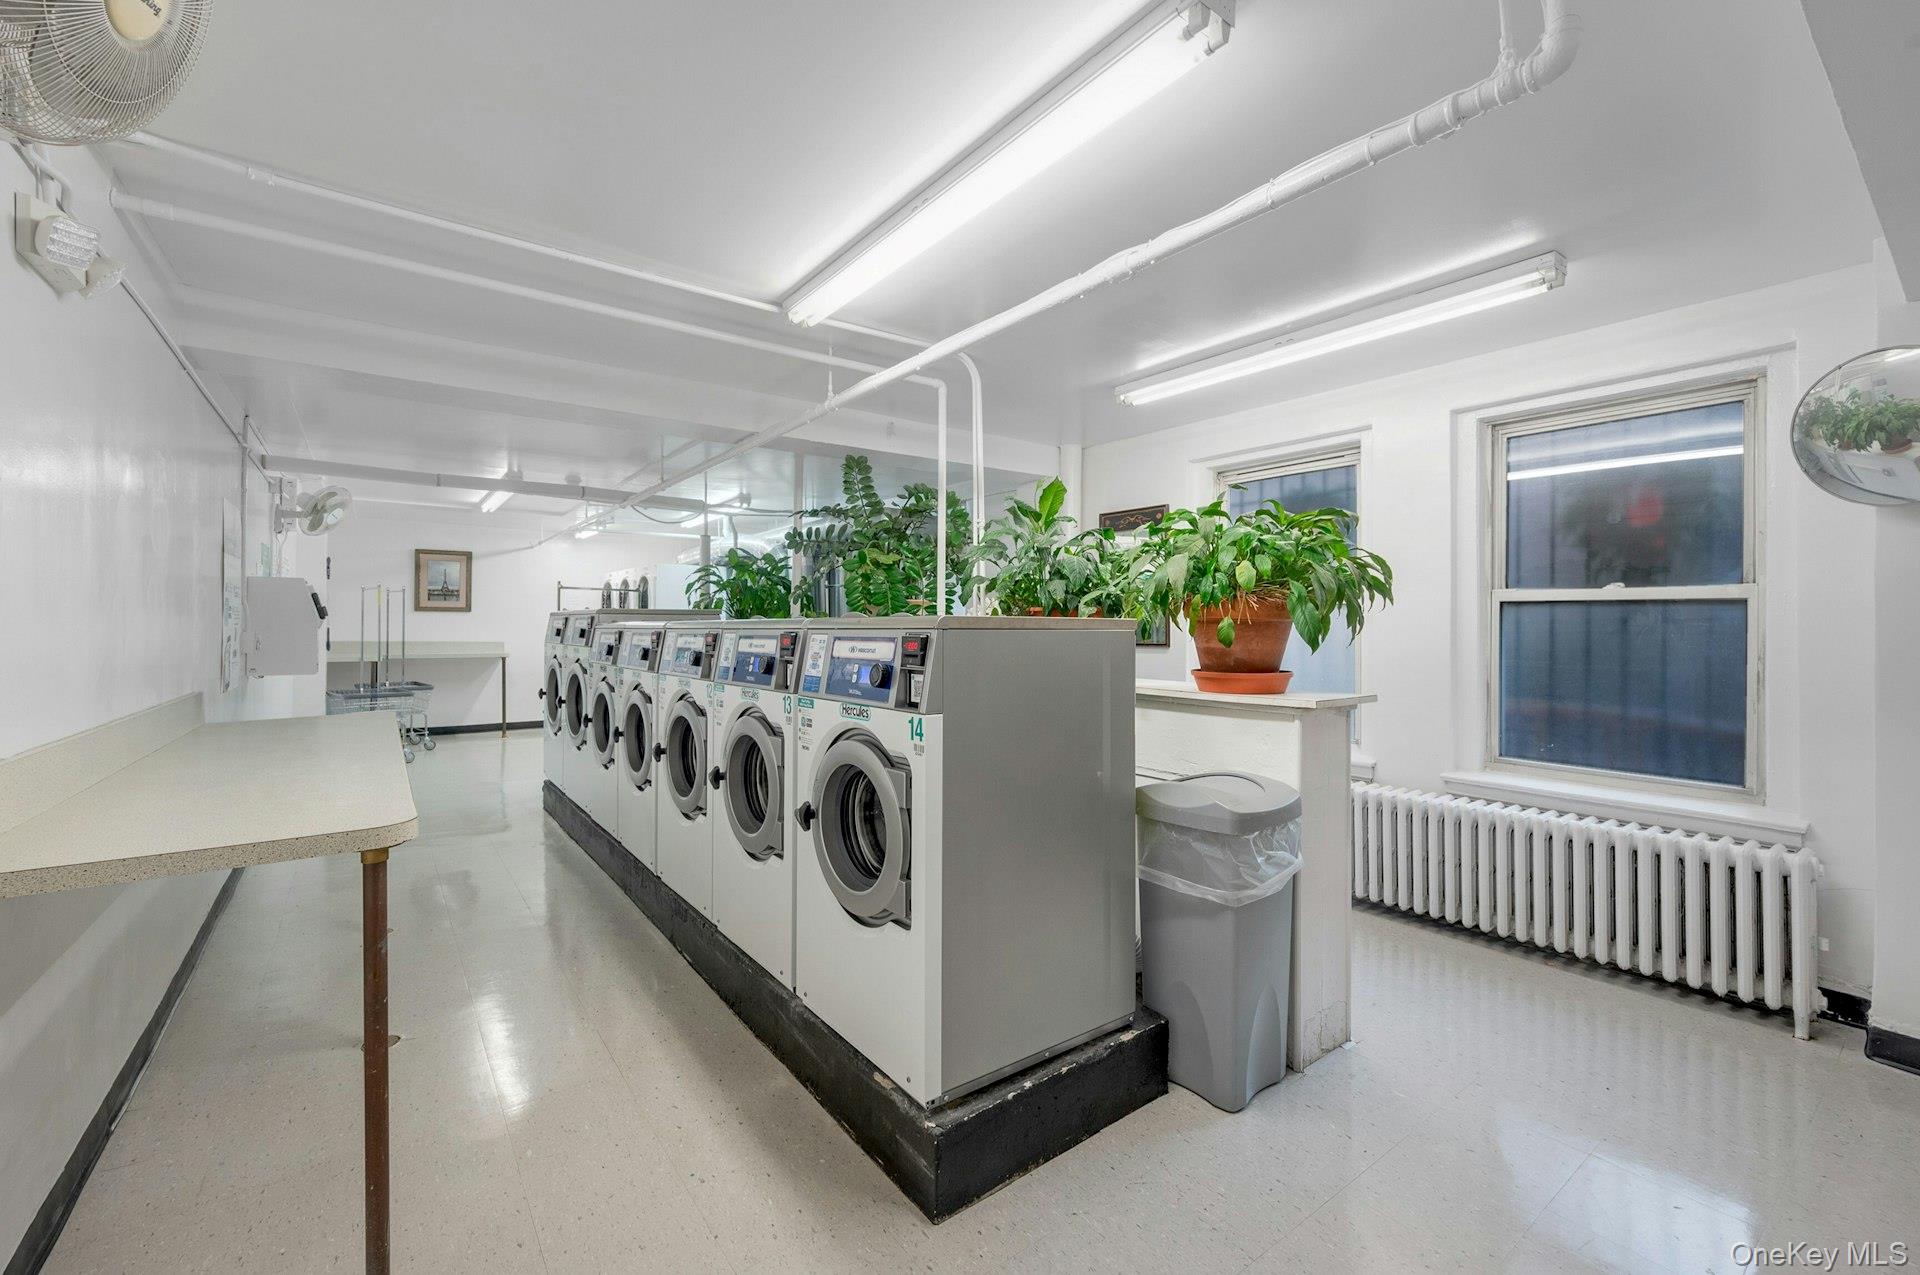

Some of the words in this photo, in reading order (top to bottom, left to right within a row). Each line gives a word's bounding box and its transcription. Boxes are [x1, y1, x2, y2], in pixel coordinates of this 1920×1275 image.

[783, 696, 792, 714] 13
[842, 703, 869, 718] Hercules
[909, 717, 923, 741] 14
